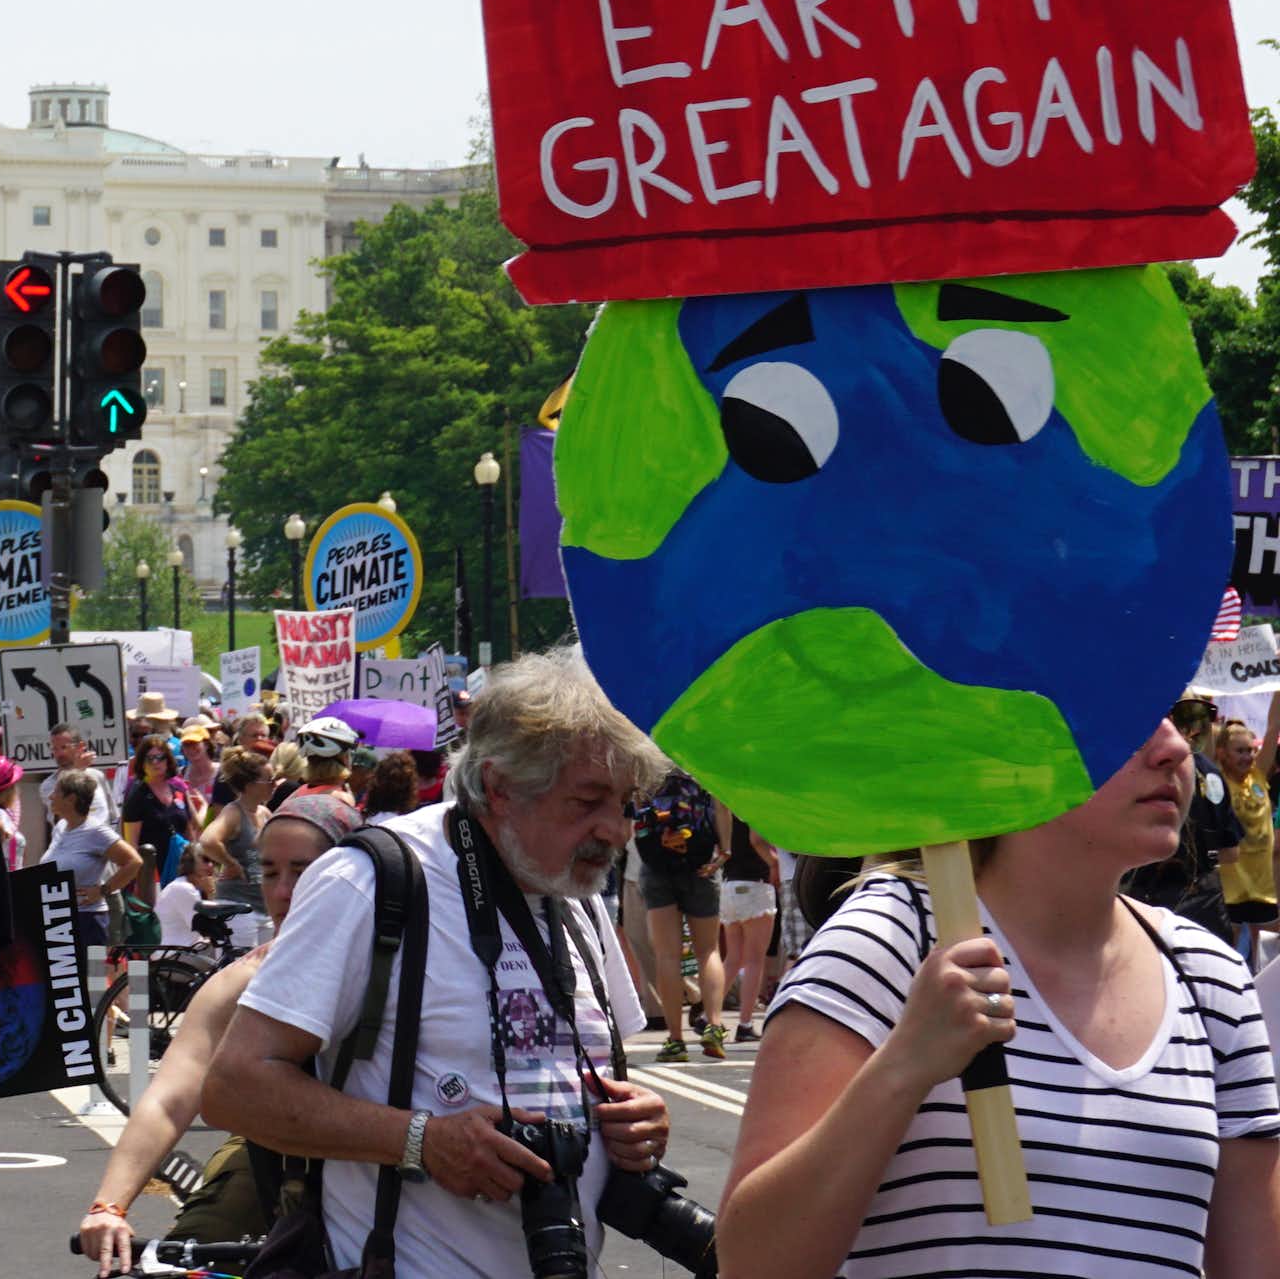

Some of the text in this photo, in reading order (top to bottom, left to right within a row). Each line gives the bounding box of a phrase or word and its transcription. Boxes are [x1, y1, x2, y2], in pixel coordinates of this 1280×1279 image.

[539, 37, 1203, 219] GREAT AGAIN
[326, 532, 392, 569] PEOPLES
[316, 548, 409, 605] CLIMATE
[326, 583, 410, 613] VEMENT
[277, 612, 353, 642] NASTY
[14, 742, 55, 762] ONL
[86, 738, 118, 757] NLY
[458, 819, 485, 911] EOS DIGITAL
[40, 880, 96, 1078] IN CLIMATE
